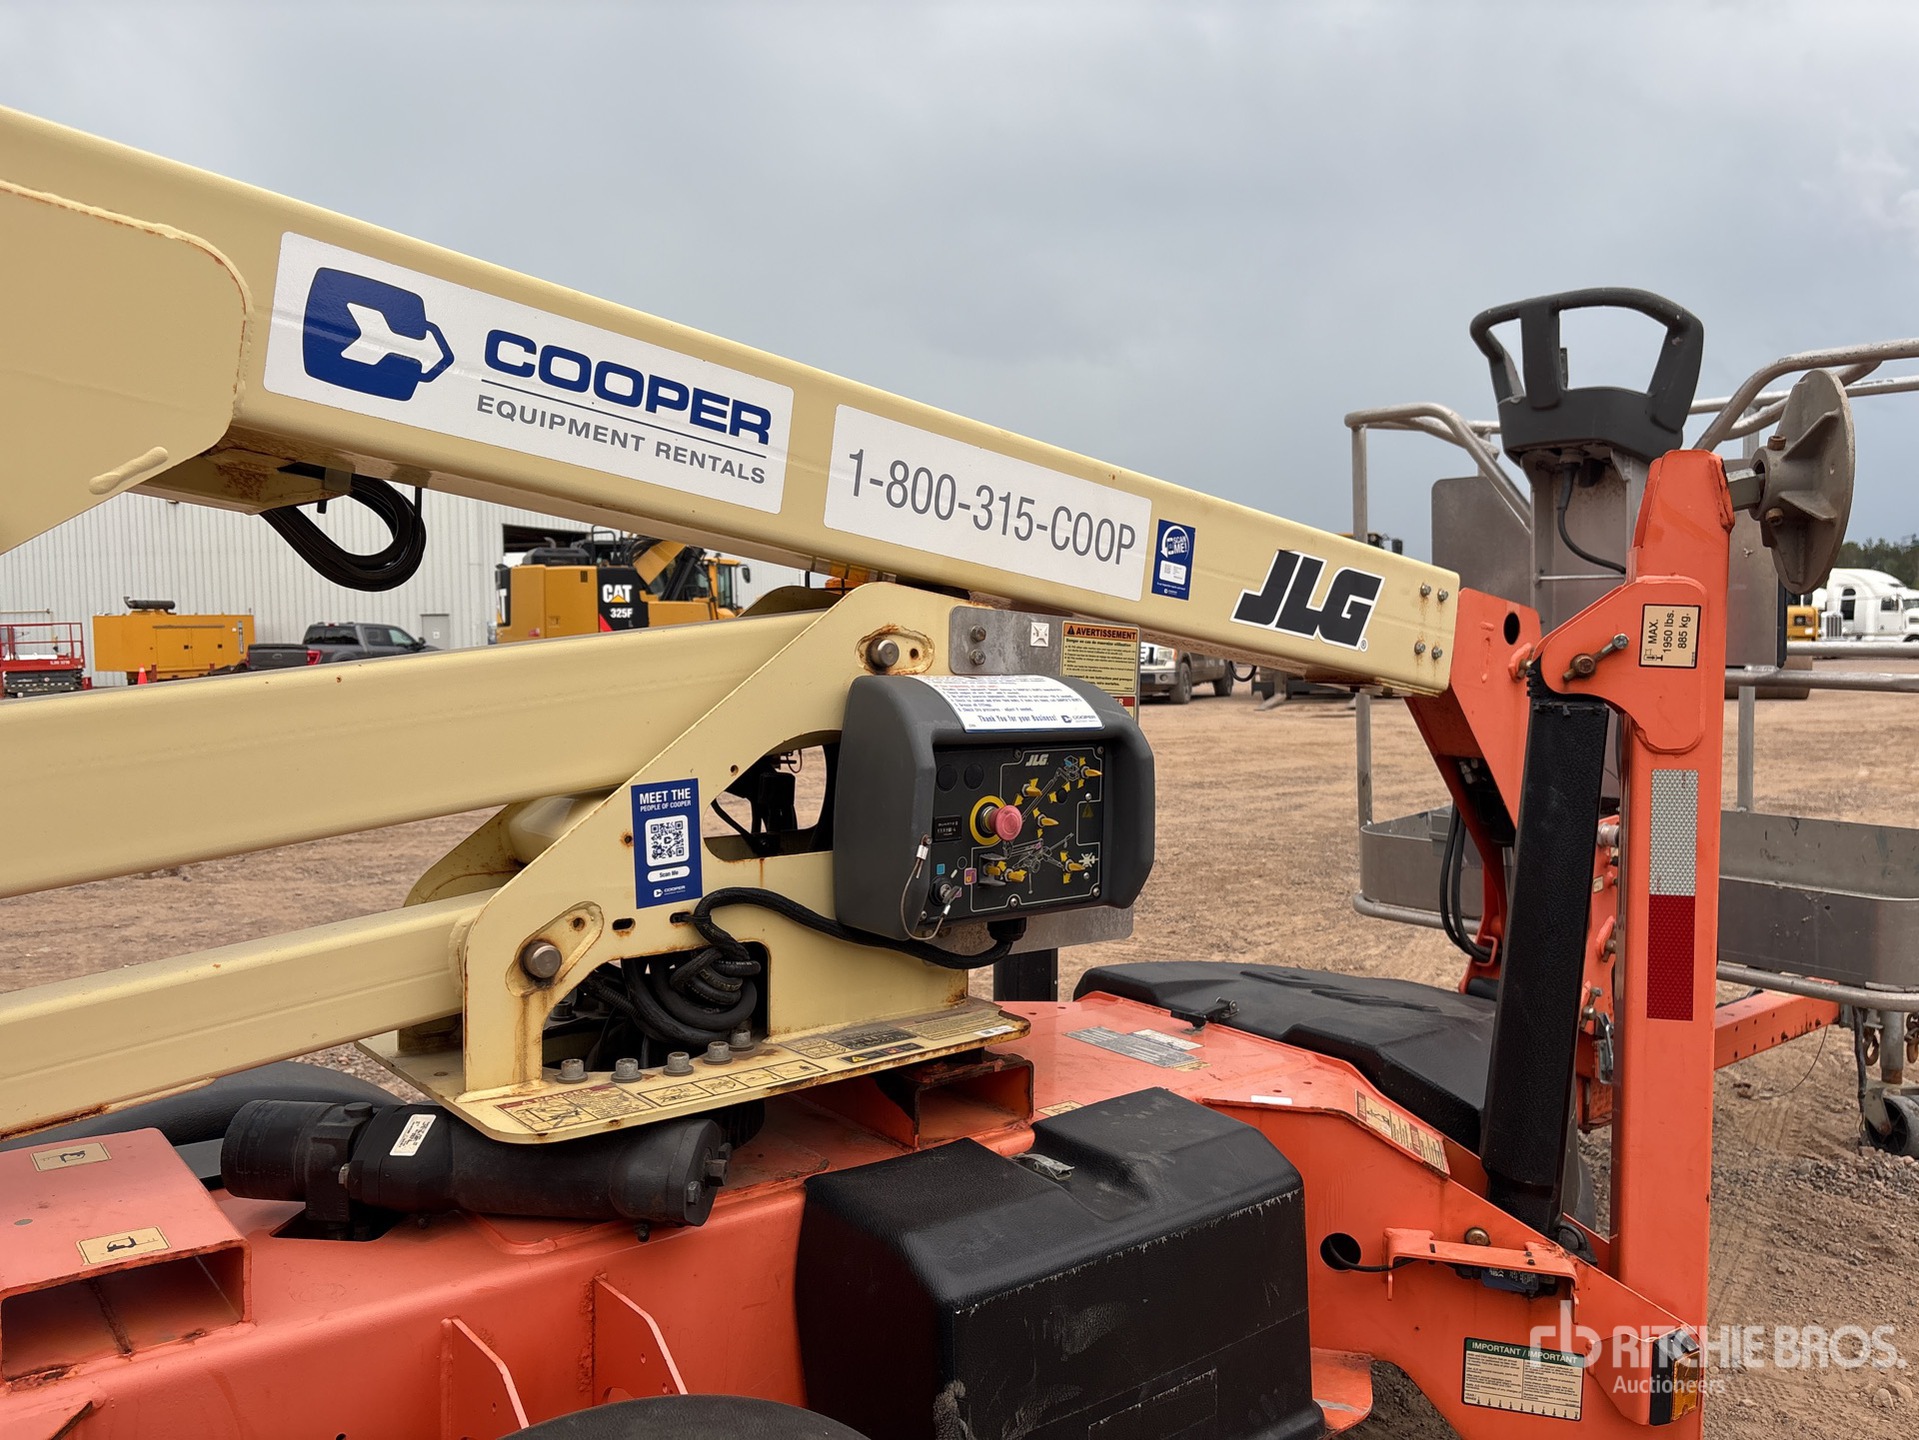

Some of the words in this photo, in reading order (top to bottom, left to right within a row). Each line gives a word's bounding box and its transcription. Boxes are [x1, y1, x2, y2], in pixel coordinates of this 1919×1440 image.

[485, 329, 772, 445] COOPER
[477, 394, 646, 453] EQUIPMENT
[655, 439, 766, 485] RENTALS
[848, 448, 1137, 566] 1-800-315-COOP
[602, 584, 633, 604] CAT
[1234, 550, 1383, 649] JLG
[609, 607, 633, 619] 325F
[1664, 610, 1674, 627] lbs.
[1679, 613, 1691, 628] kg.
[1076, 627, 1136, 640] AVERTISSEMENT
[1648, 619, 1658, 644] MAX.
[1678, 631, 1688, 649] 885
[1663, 630, 1673, 653] 1950
[1025, 754, 1049, 766] JLG
[639, 790, 669, 805] MEET
[671, 787, 691, 801] THE
[640, 803, 661, 812] PEOPLE
[661, 802, 669, 810] OF
[670, 800, 692, 809] COOPER
[1471, 1341, 1522, 1356] IMPORTANT
[1527, 1350, 1578, 1365] IMPORTANT
